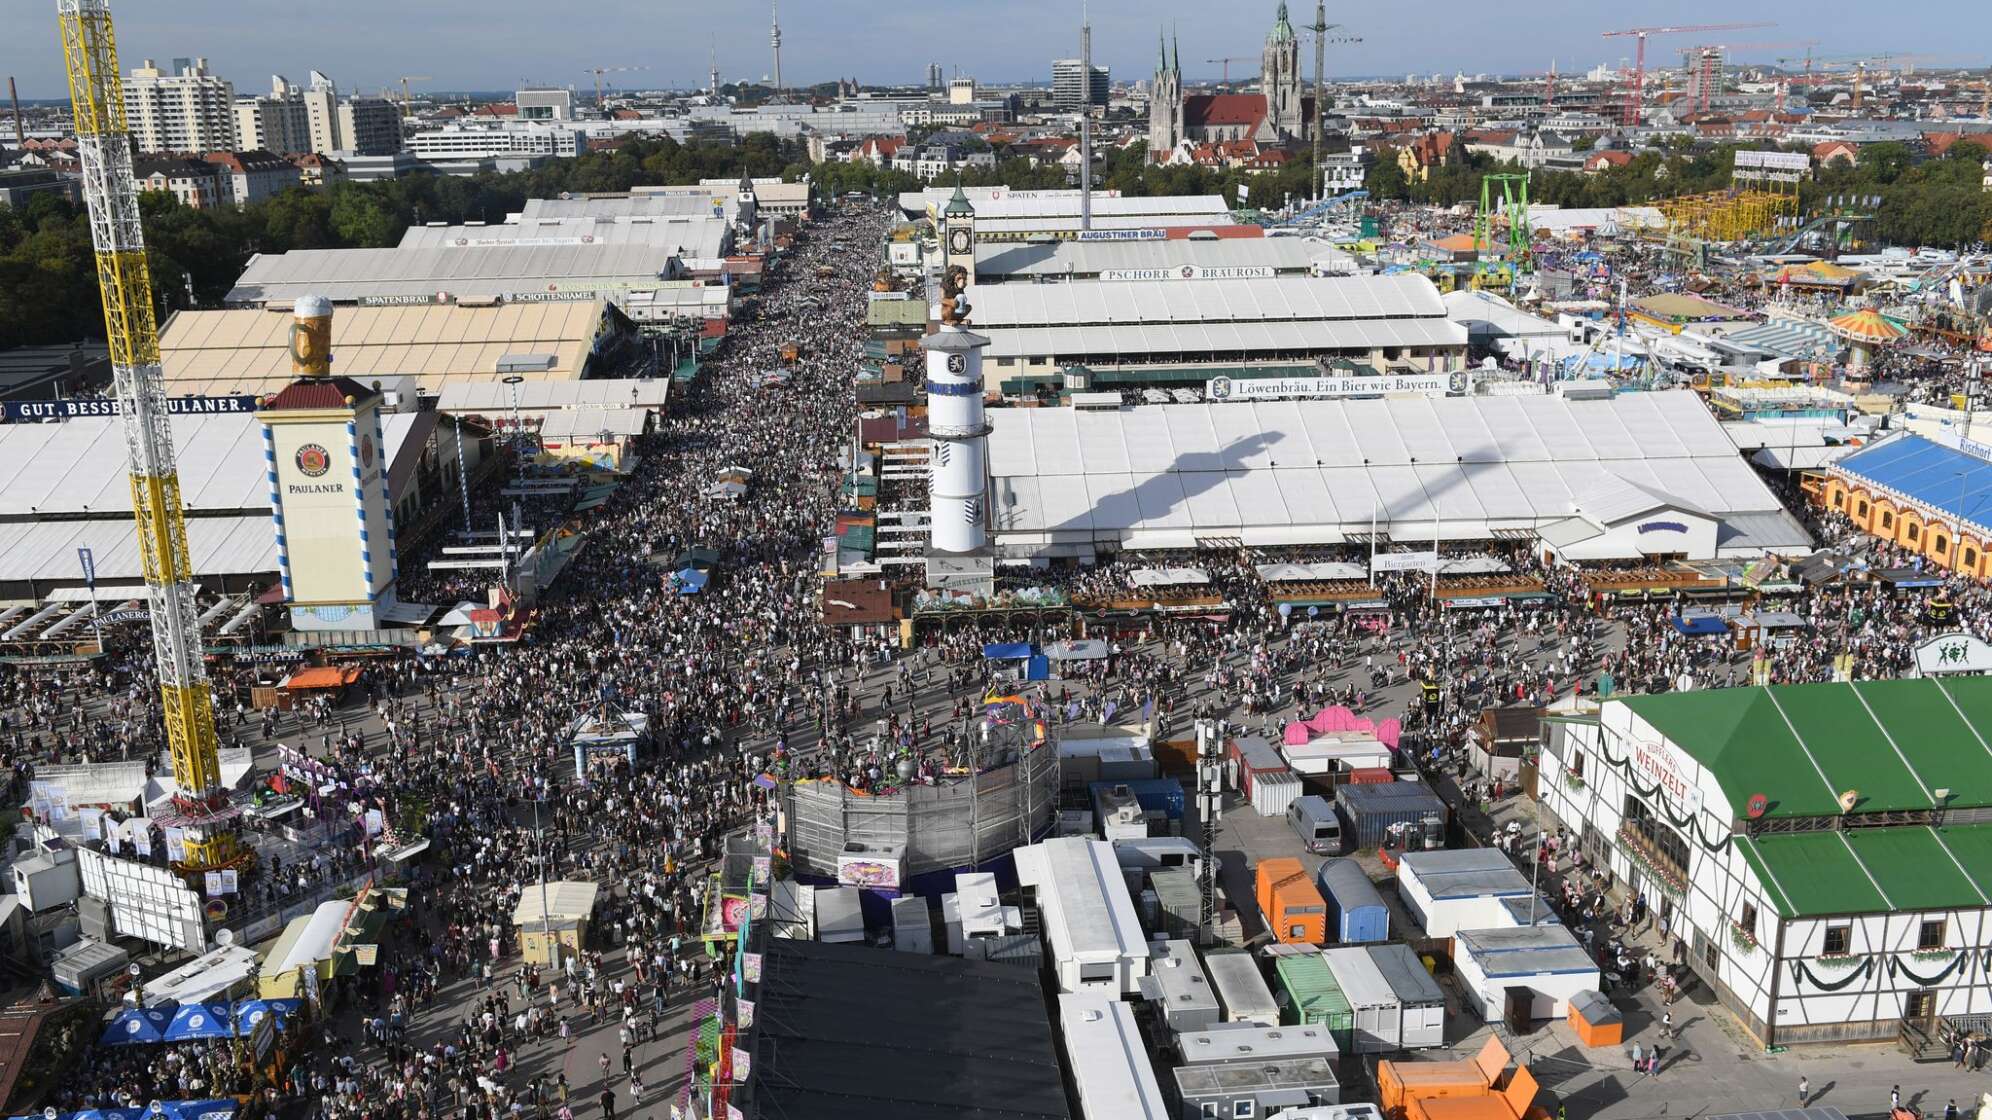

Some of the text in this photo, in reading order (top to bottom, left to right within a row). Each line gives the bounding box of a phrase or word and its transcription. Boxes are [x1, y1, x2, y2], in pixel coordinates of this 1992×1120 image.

[1080, 229, 1165, 239] AUGUSTINER BRÄU
[1109, 270, 1170, 279] PSCHORR
[516, 291, 594, 301] SCHOTTENHAMEL
[1239, 377, 1442, 394] Löwenbräu. Ein Bier wie Bayern.
[67, 402, 124, 415] BESSE
[169, 398, 247, 412] ULANER.
[1960, 439, 1991, 459] Rischart
[289, 484, 343, 493] PAULANER
[1636, 746, 1688, 801] WEINZELT
